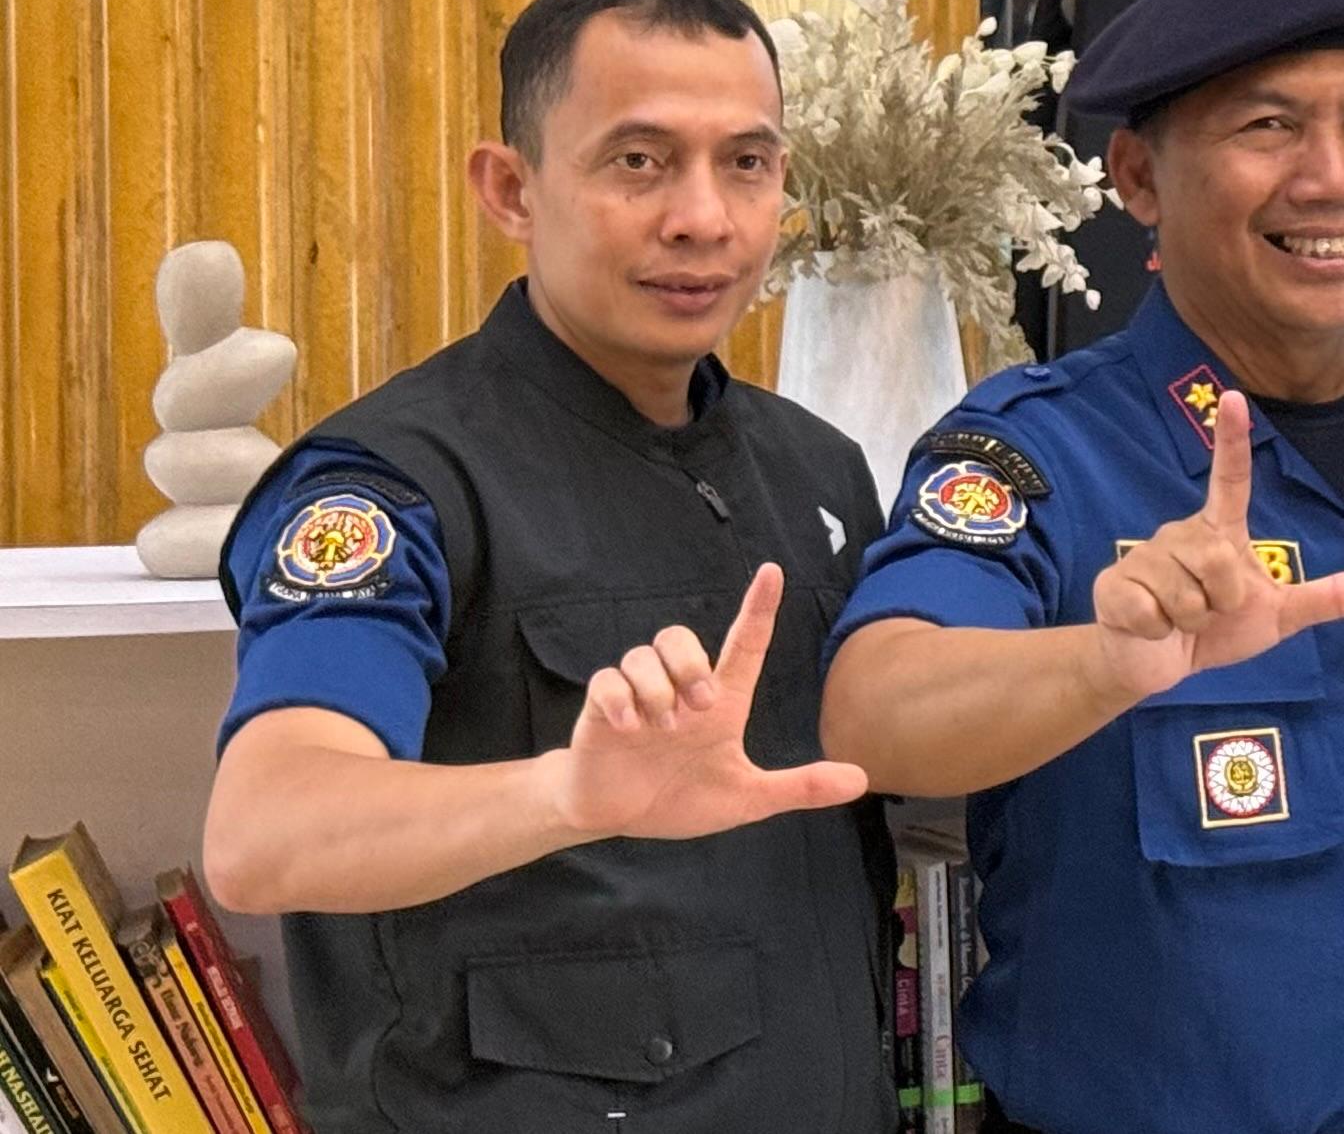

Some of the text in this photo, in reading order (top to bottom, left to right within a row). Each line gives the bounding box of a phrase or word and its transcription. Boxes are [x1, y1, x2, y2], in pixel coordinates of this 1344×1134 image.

[47, 888, 81, 935] KIAT
[71, 933, 136, 1041] KELUARGA
[127, 1040, 172, 1101] SEHAT
